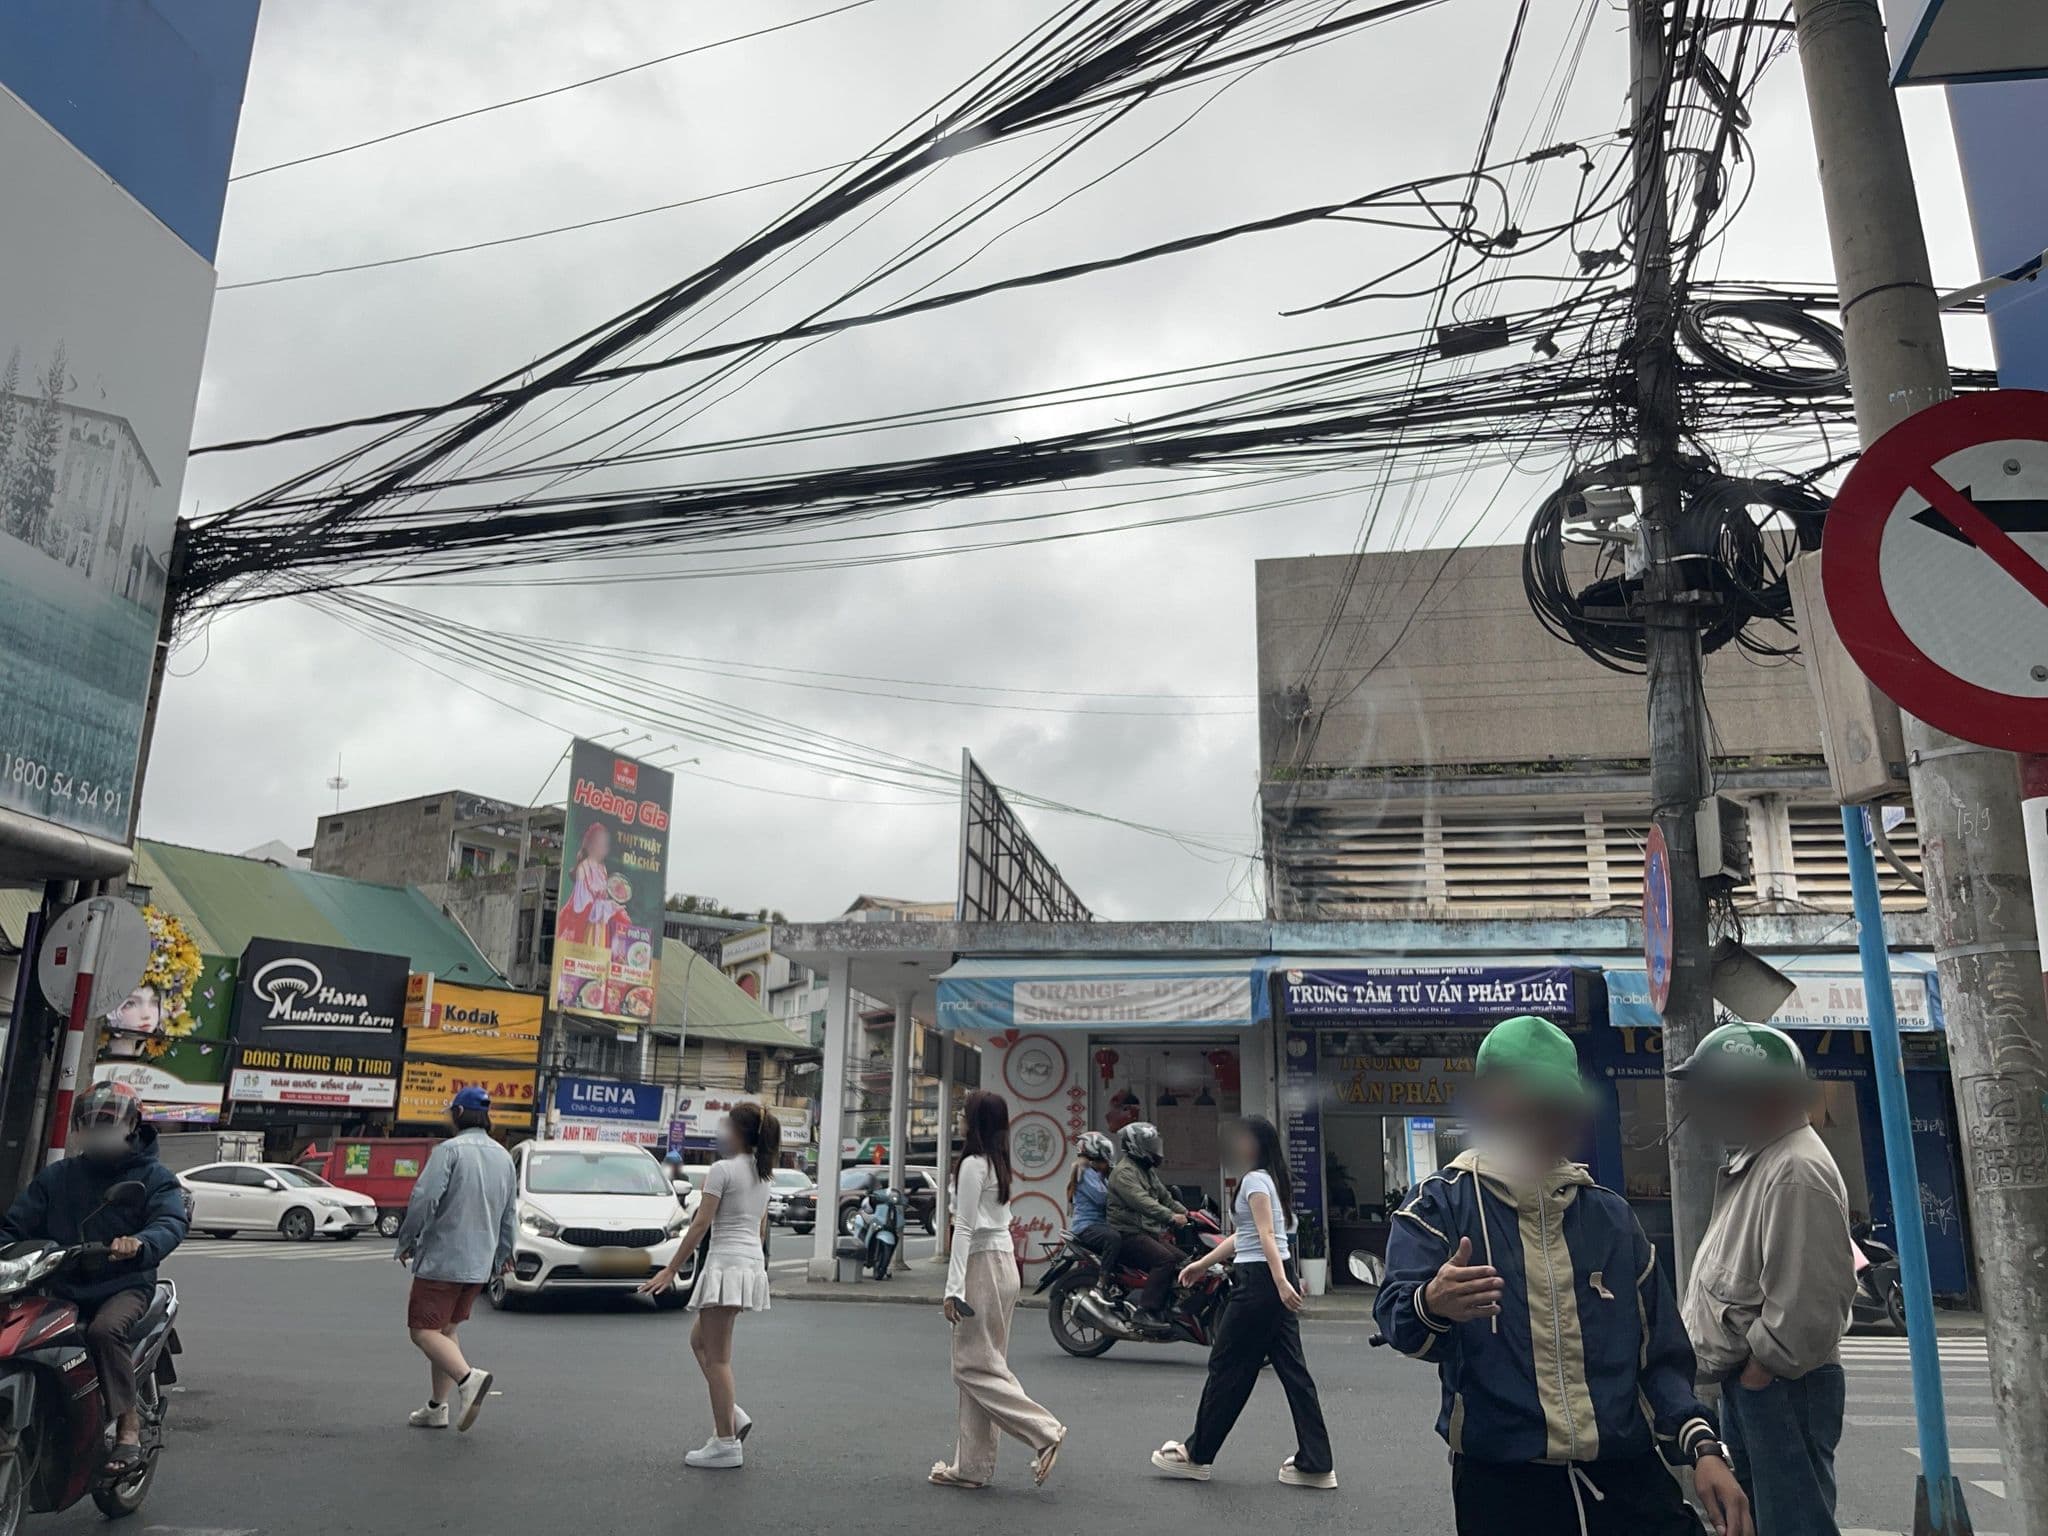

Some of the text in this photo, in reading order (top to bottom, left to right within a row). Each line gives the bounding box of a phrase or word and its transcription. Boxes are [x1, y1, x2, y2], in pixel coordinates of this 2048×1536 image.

[3, 753, 123, 816] 1800 54 54 91
[574, 778, 669, 832] Hoàng Gia
[319, 987, 368, 1007] Hana
[1030, 983, 1127, 1001] ORANGE
[1289, 976, 1568, 1005] TRUNG TÂM TƯ VẤN PHÁP LUẬT
[268, 991, 394, 1027] Mushroom farm
[445, 1005, 500, 1025] Kodak
[1024, 1004, 1149, 1022] SMOOTHIE
[1722, 1039, 1768, 1061] Grab
[284, 1052, 331, 1071] TRUNG
[334, 1056, 352, 1076] HẠ
[1334, 1073, 1384, 1104] VẤN
